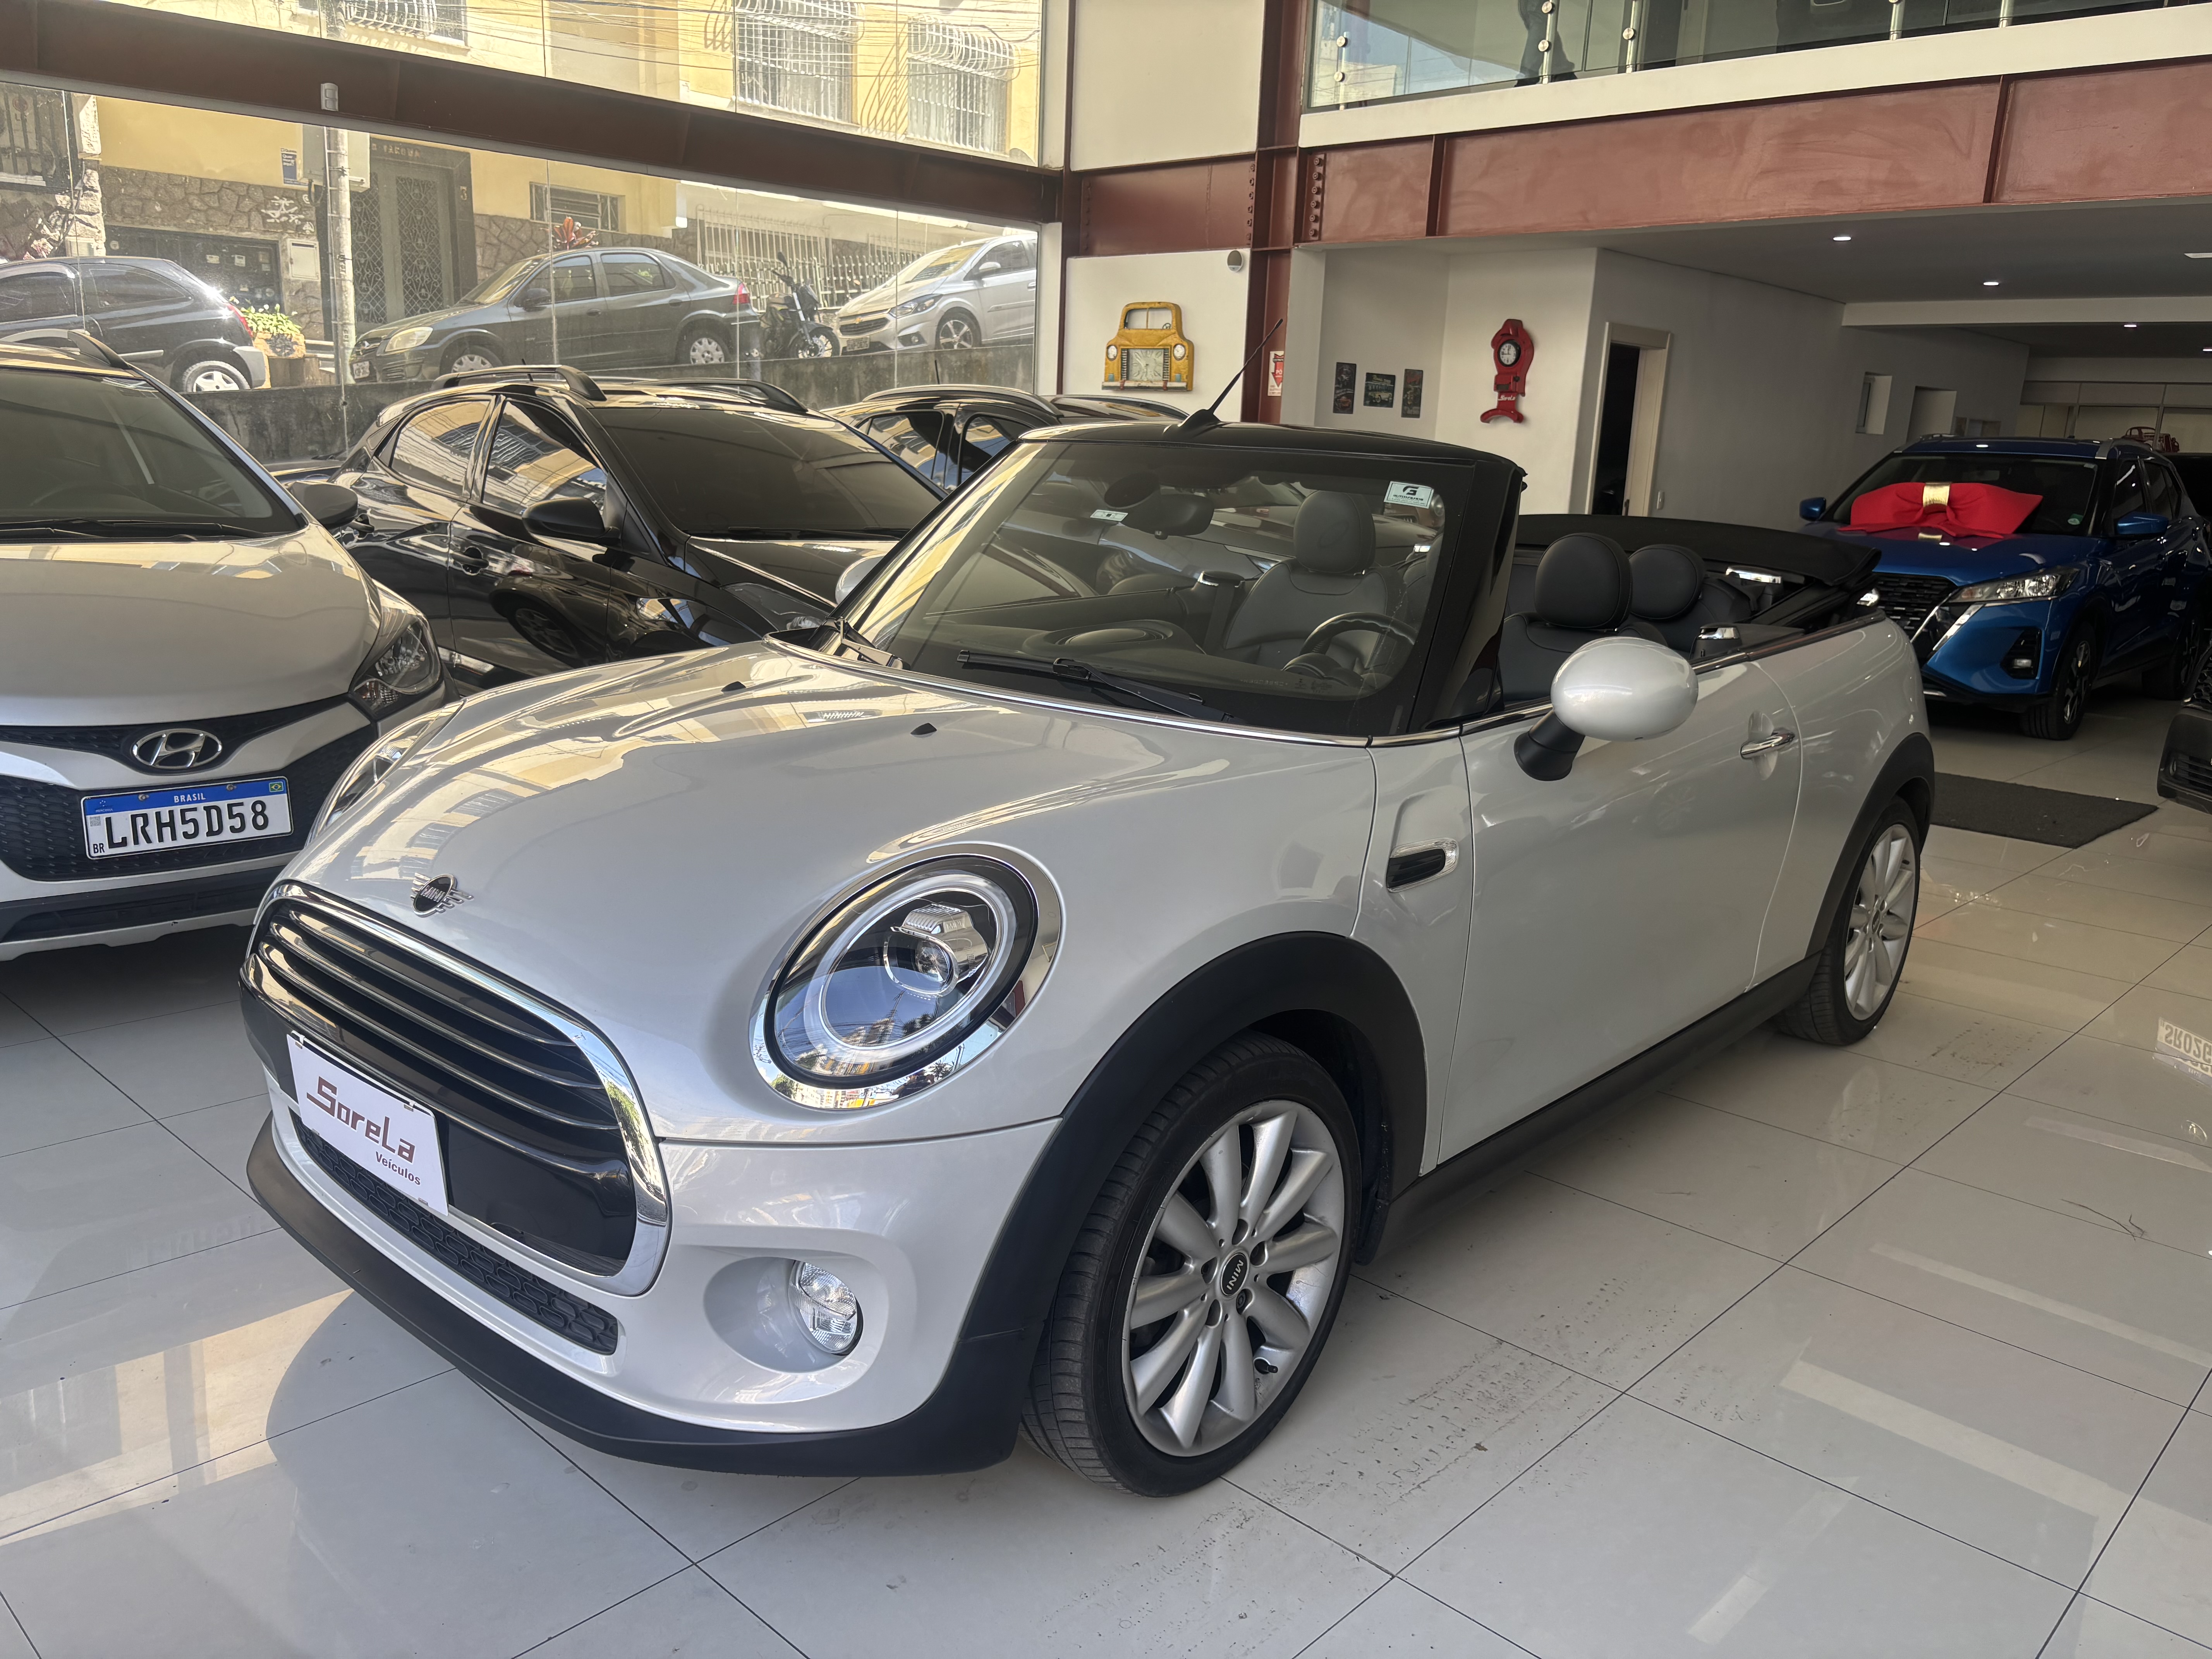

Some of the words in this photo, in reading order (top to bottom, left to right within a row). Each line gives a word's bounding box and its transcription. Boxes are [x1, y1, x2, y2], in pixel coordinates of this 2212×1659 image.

[173, 793, 206, 803] BRASIL
[106, 800, 269, 849] LRH5D58
[93, 843, 105, 854] BR
[420, 885, 446, 902] MINI
[376, 1151, 421, 1185] Veículos
[1226, 1259, 1244, 1291] MINI
